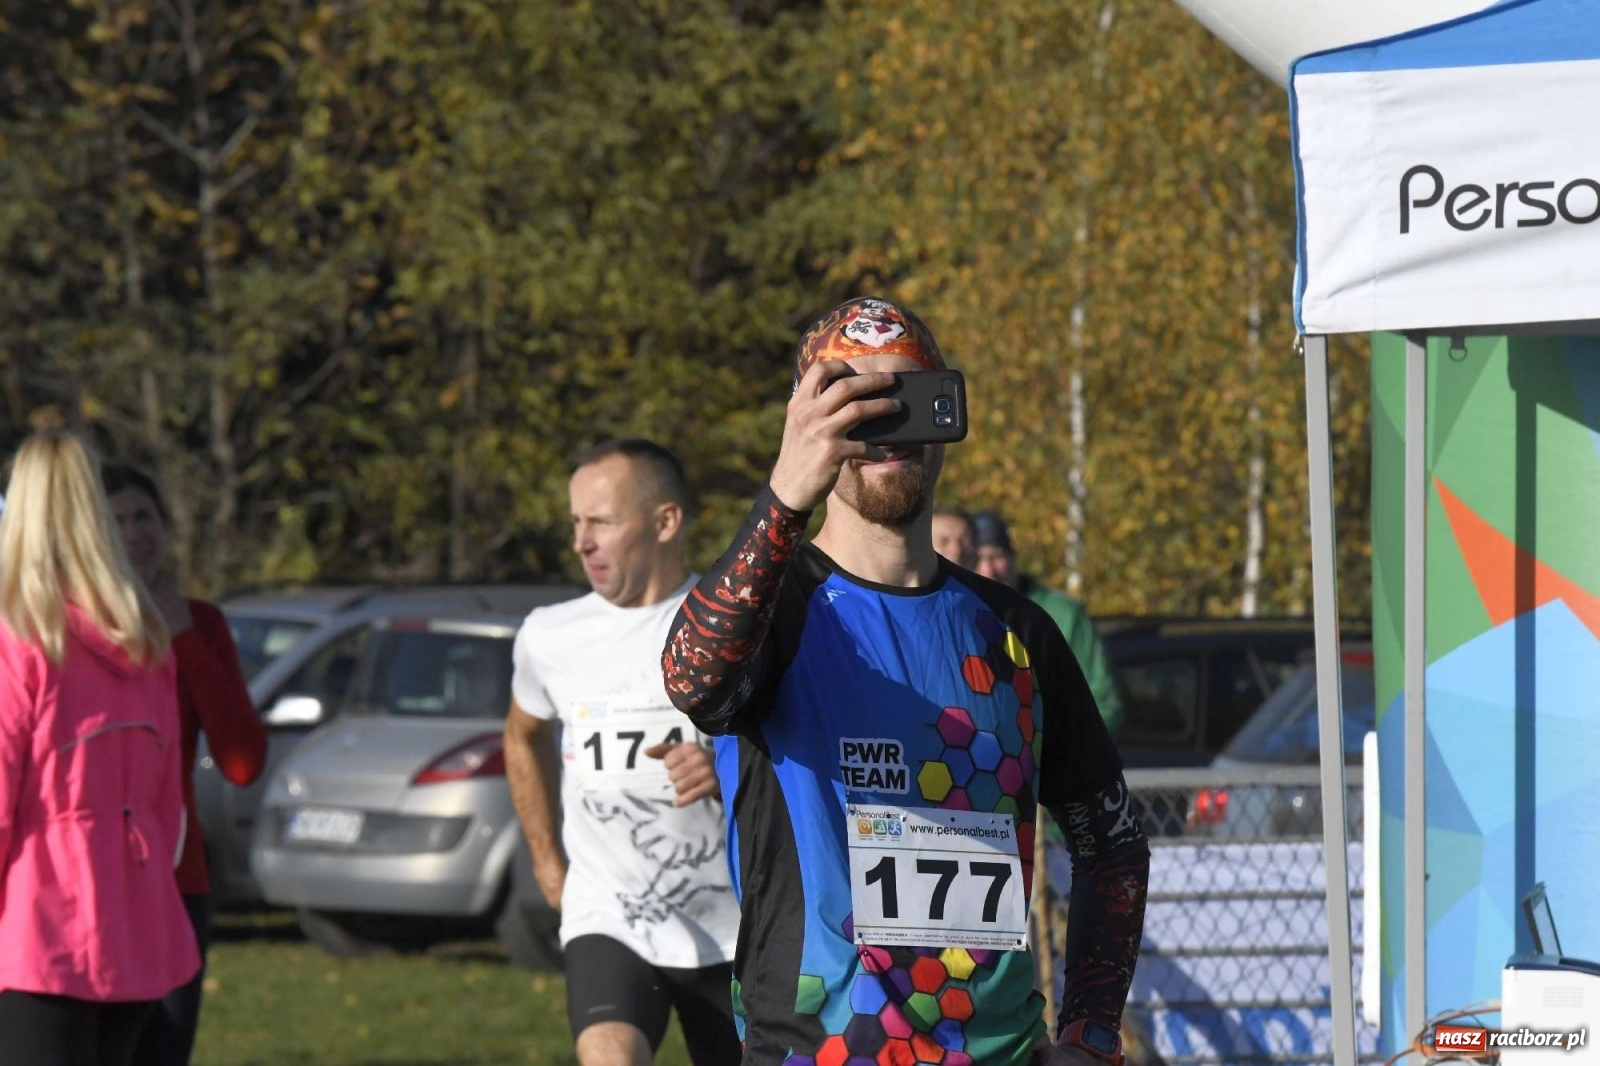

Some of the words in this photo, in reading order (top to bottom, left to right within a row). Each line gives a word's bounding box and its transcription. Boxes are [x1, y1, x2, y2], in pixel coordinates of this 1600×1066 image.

[1399, 164, 1600, 234] Perso
[842, 741, 900, 764] PWR
[839, 766, 906, 790] TEAM
[909, 823, 1010, 840] www.personalbest.pl
[865, 856, 1012, 923] 177
